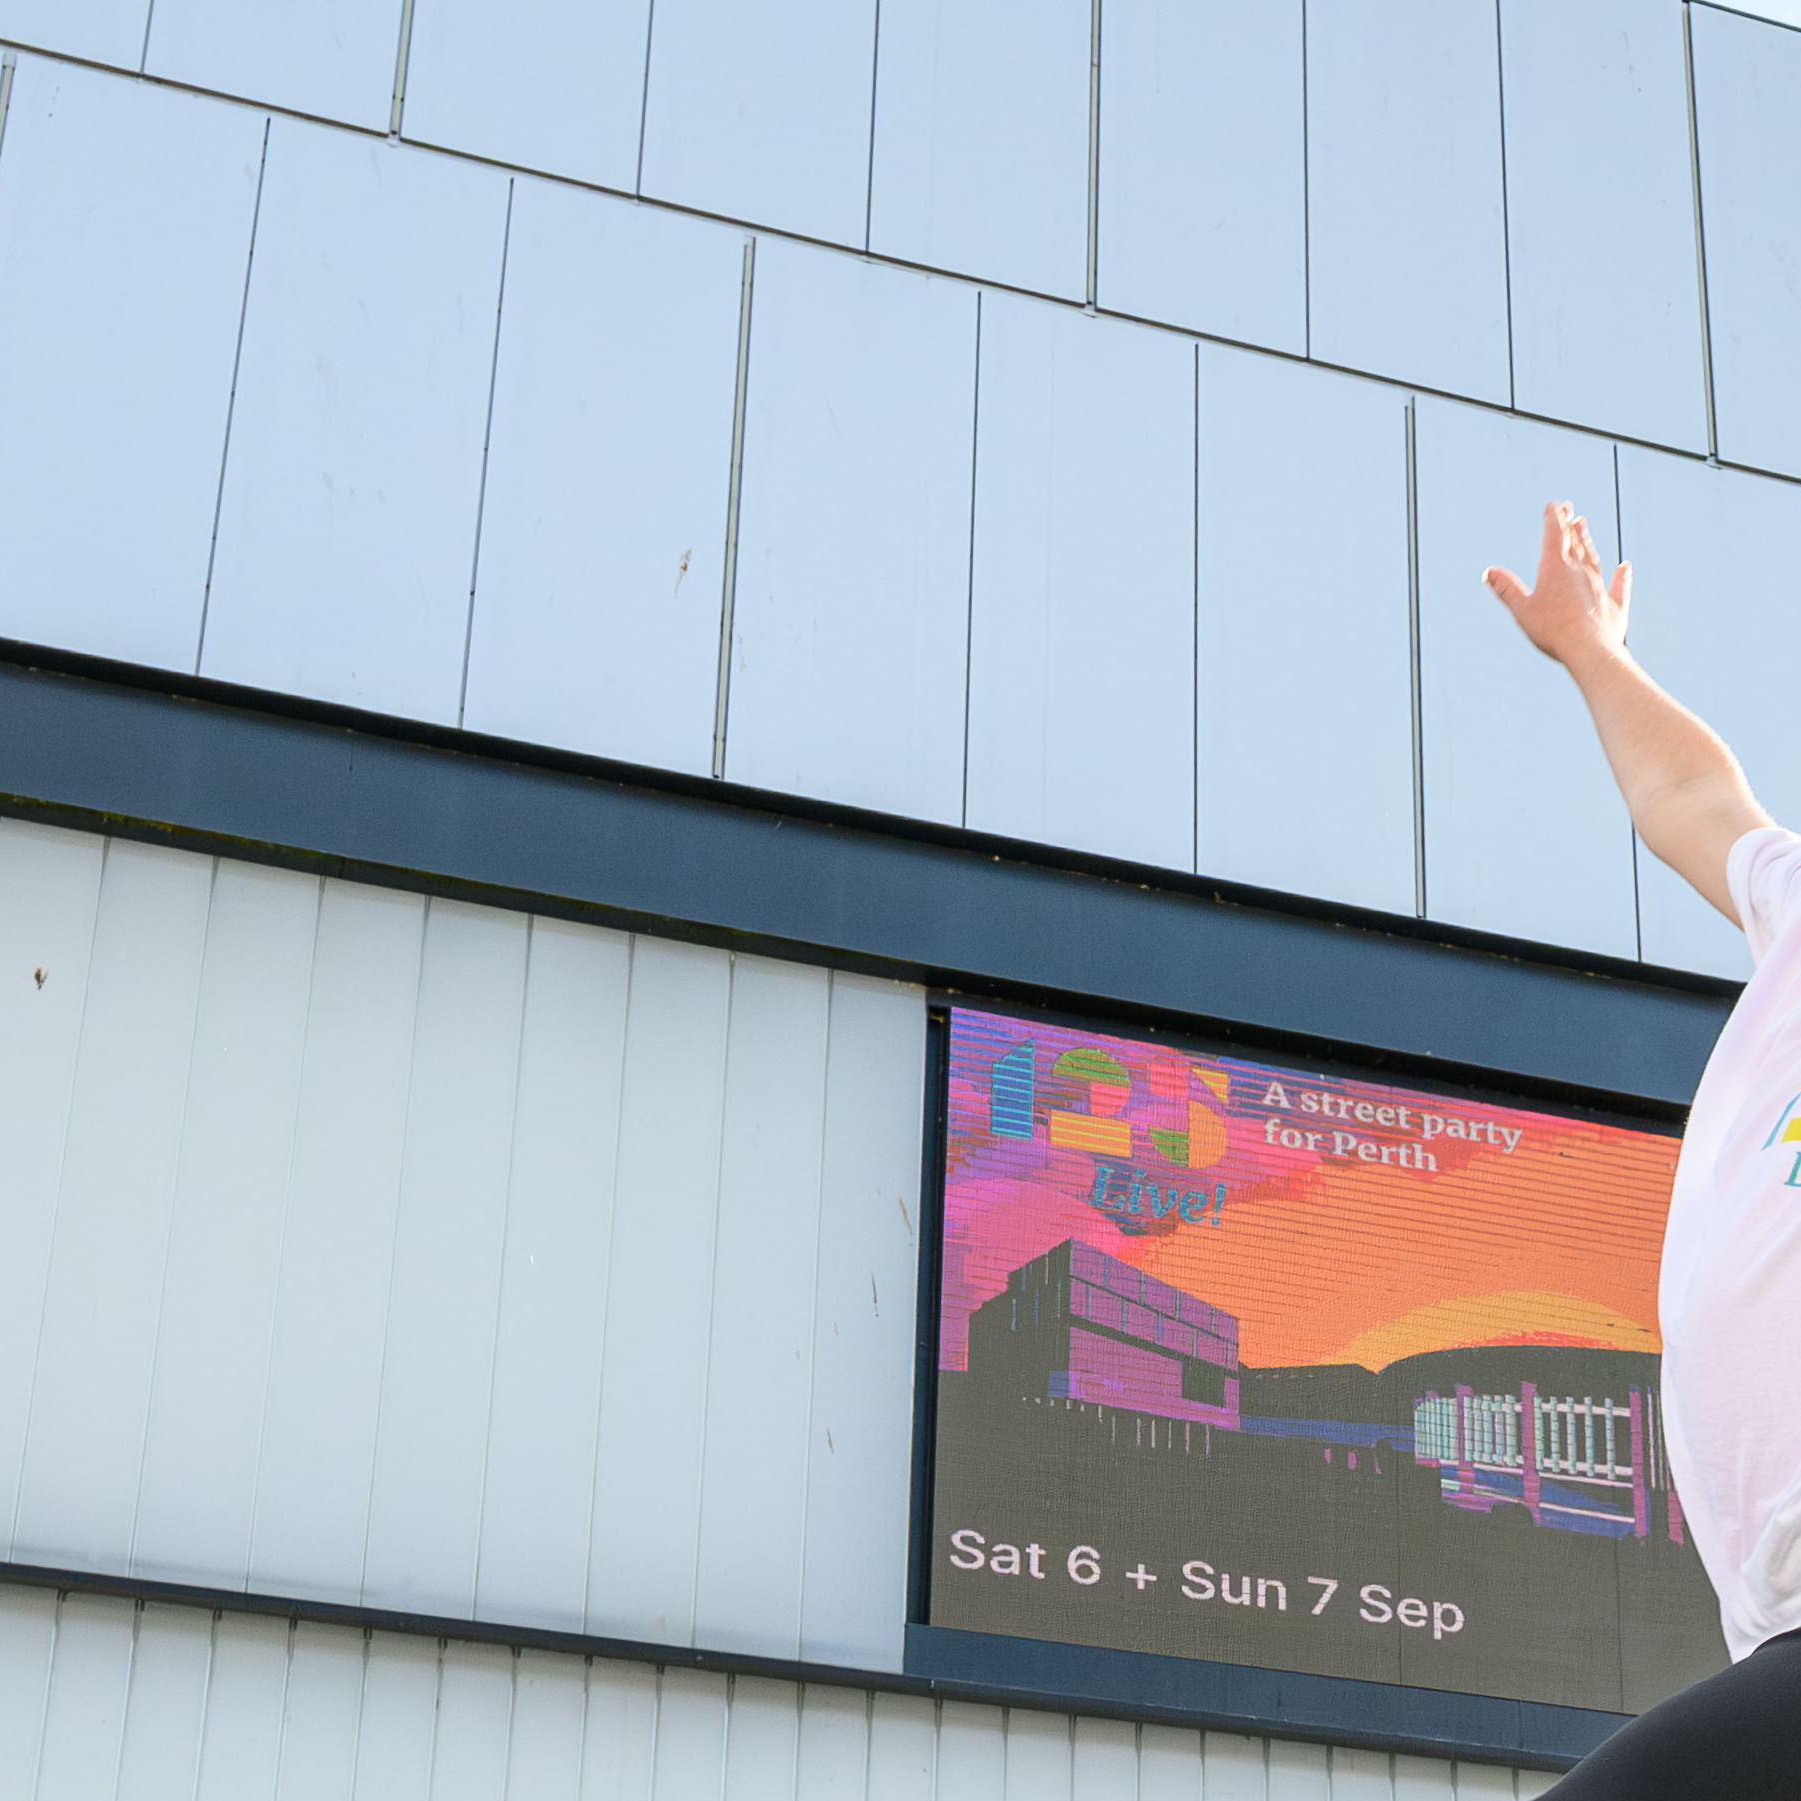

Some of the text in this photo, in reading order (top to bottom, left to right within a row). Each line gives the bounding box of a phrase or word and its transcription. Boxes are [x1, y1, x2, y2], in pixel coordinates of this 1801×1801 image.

[1263, 1081, 1522, 1153] A street party
[1264, 1118, 1438, 1171] for Perth
[1088, 1166, 1227, 1226] Live!
[950, 1529, 1464, 1640] Sat 6 + Sun 7 Sep
